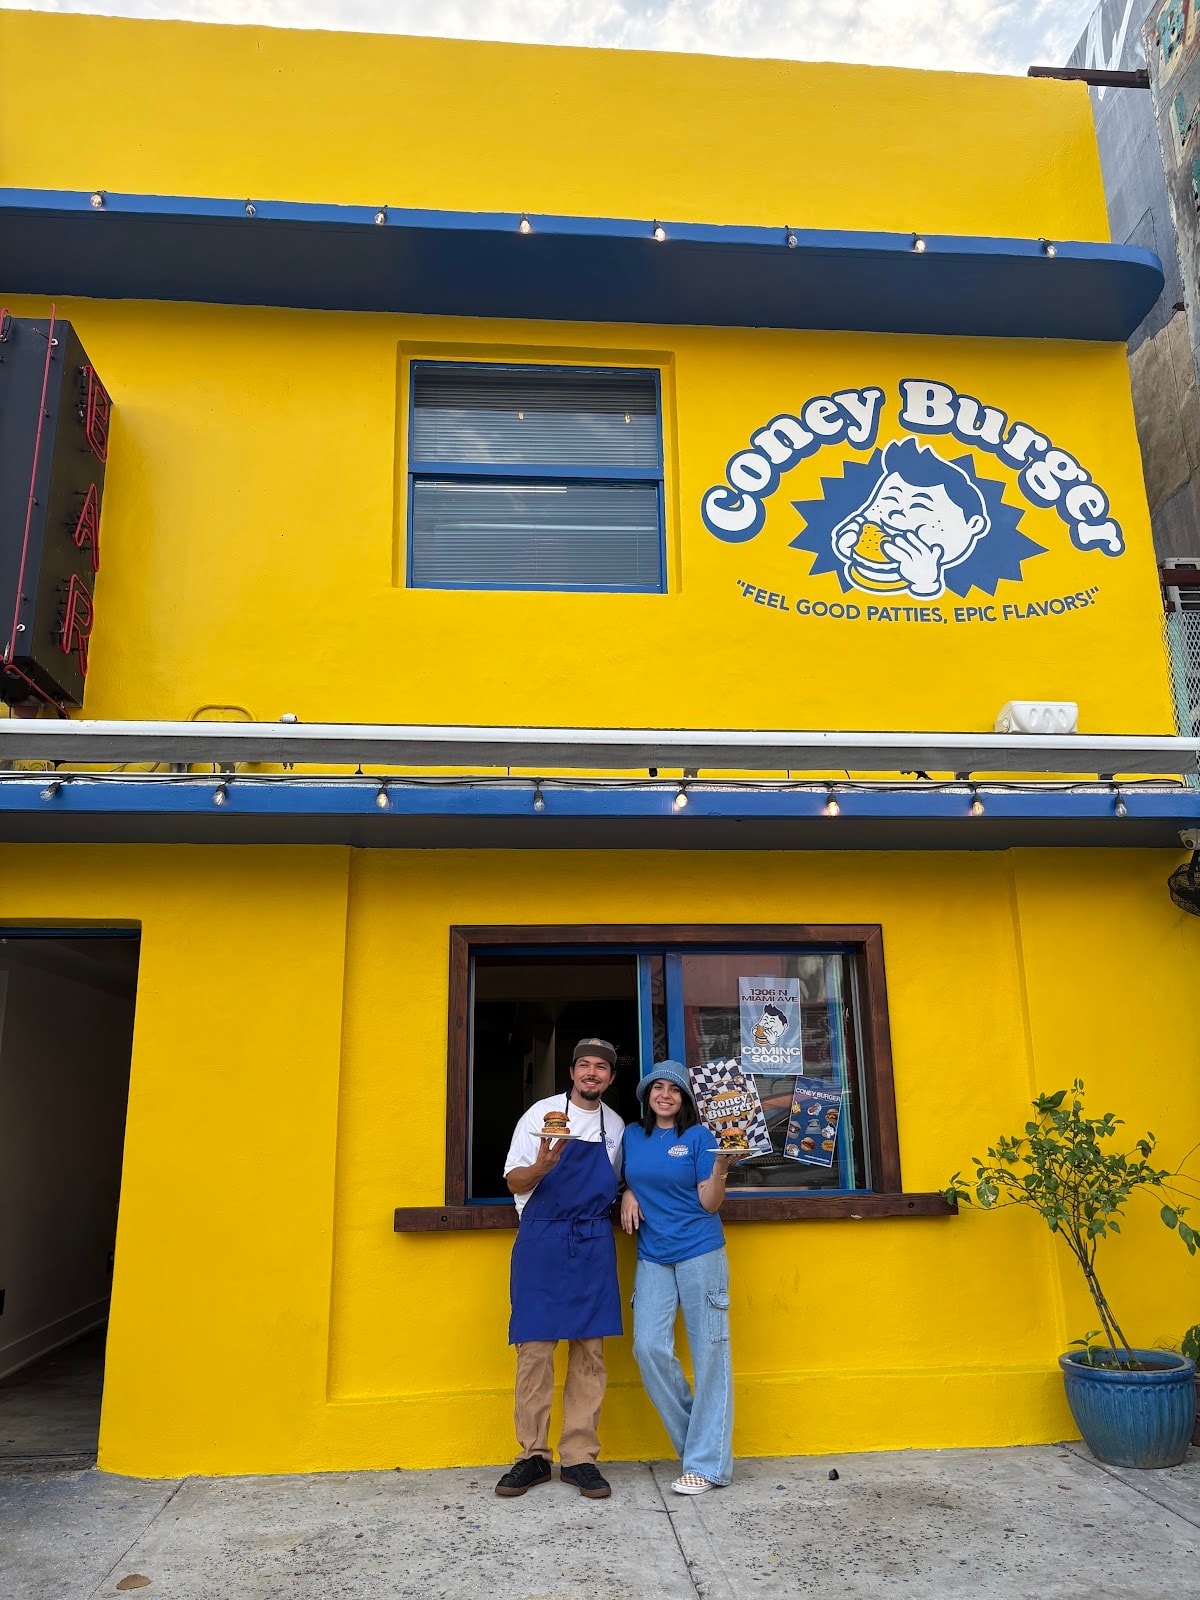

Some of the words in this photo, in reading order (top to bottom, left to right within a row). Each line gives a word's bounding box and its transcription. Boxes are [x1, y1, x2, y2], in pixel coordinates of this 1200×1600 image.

[701, 386, 885, 543] Coney
[899, 378, 1126, 557] Burger
[796, 599, 861, 620] GOOD
[867, 605, 948, 624] PATTIES,
[954, 605, 997, 623] EPIC
[750, 988, 776, 996] 1306
[742, 1046, 800, 1056] COMING
[751, 1055, 791, 1063] SOON
[795, 1087, 816, 1097] CONEY
[709, 1094, 748, 1110] Coney
[706, 1102, 752, 1120] Burger
